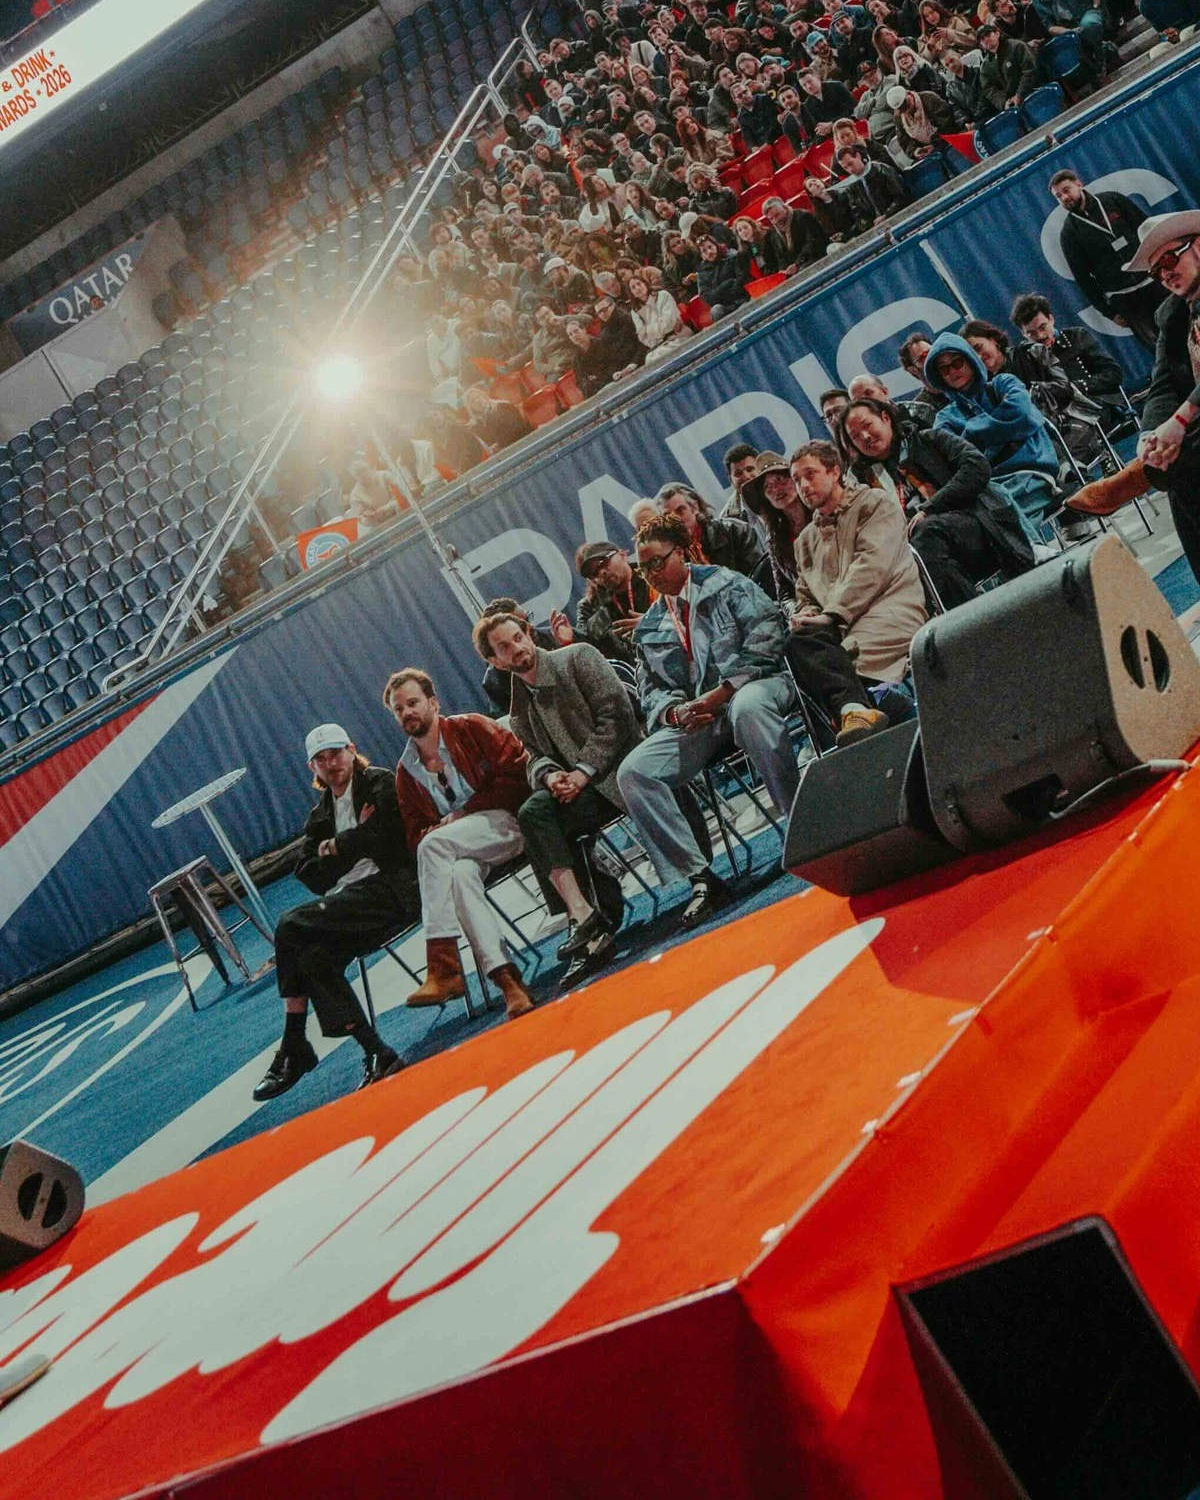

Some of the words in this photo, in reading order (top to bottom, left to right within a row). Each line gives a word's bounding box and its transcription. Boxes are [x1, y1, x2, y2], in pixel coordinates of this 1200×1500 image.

[0, 89, 37, 131] ARDS
[40, 63, 72, 98] 2026
[1, 81, 13, 93] &
[10, 49, 53, 88] DRINK
[49, 253, 134, 325] QATAR
